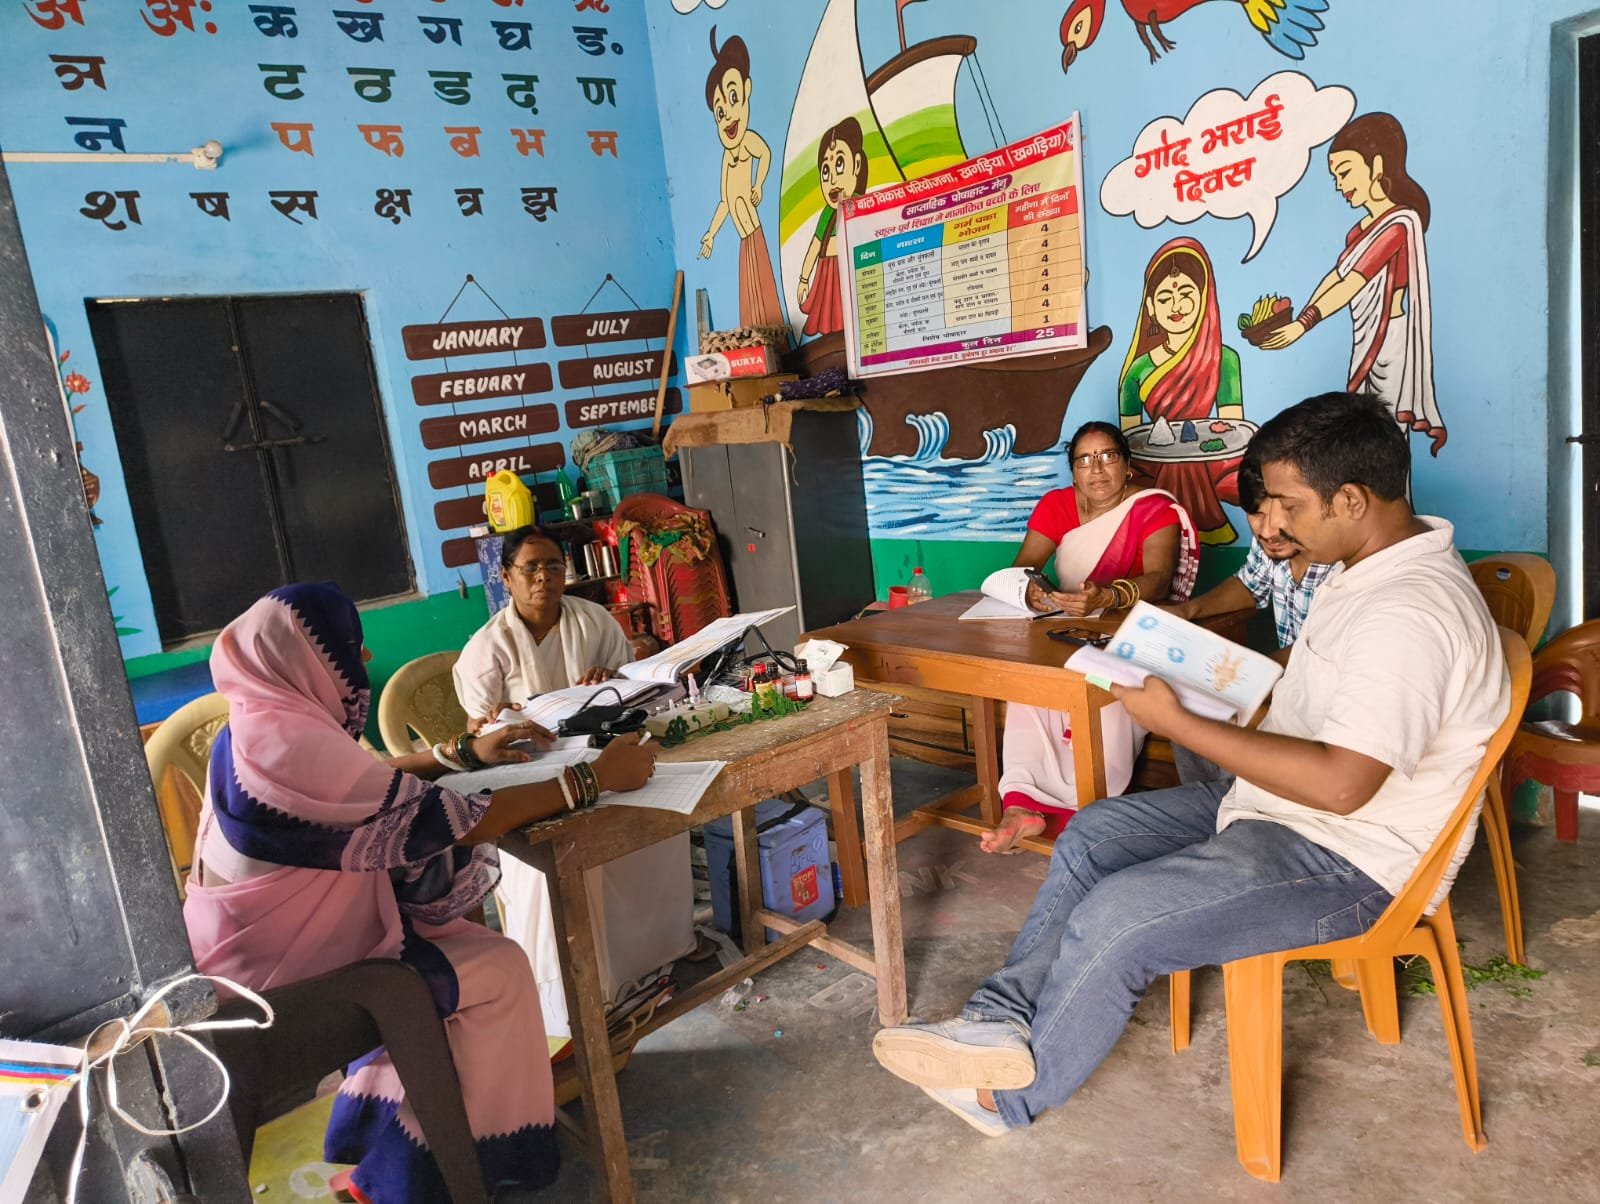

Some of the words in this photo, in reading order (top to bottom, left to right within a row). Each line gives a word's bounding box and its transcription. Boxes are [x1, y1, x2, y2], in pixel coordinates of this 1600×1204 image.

[247, 4, 298, 38] क
[332, 9, 386, 43] ख
[416, 15, 463, 47] ग
[490, 20, 533, 51] घ
[257, 63, 308, 102] ट
[346, 67, 397, 103] ठ
[427, 70, 473, 106] ड
[575, 76, 617, 107] ण
[66, 116, 127, 154] न
[271, 122, 314, 156] प
[356, 124, 404, 158] फ
[444, 126, 482, 158] ब
[510, 128, 547, 157] भ
[587, 130, 620, 158] म
[1135, 131, 1192, 178] गोद
[1201, 94, 1285, 154] भराई
[876, 189, 905, 206] विकास
[959, 157, 1004, 181] खगड़िया
[1172, 157, 1256, 203] दिवस
[79, 190, 143, 231] श
[189, 191, 231, 221] ष
[268, 190, 319, 225] स
[374, 188, 413, 225] क्ष
[874, 225, 896, 238] स्कूल
[912, 215, 933, 231] शिक्षा
[1009, 189, 1019, 201] के
[1021, 183, 1041, 198] लिए
[906, 197, 946, 216] साप्ताहिक
[1040, 223, 1049, 233] 4
[1040, 239, 1049, 248] 4
[1040, 254, 1049, 263] 4
[1040, 269, 1049, 278] 4
[1041, 283, 1049, 292] 4
[1041, 299, 1050, 308] 4
[586, 318, 630, 338] JULY
[1042, 315, 1050, 324] 1
[433, 326, 523, 351] JANUARY
[1035, 328, 1055, 339] 25
[593, 358, 655, 380] AUGUST
[730, 356, 763, 368] SURYA
[440, 372, 526, 398] FEBUARY
[579, 396, 657, 421] SEPTEMBE
[459, 414, 527, 438] MARCH
[468, 455, 532, 479] APRIL
